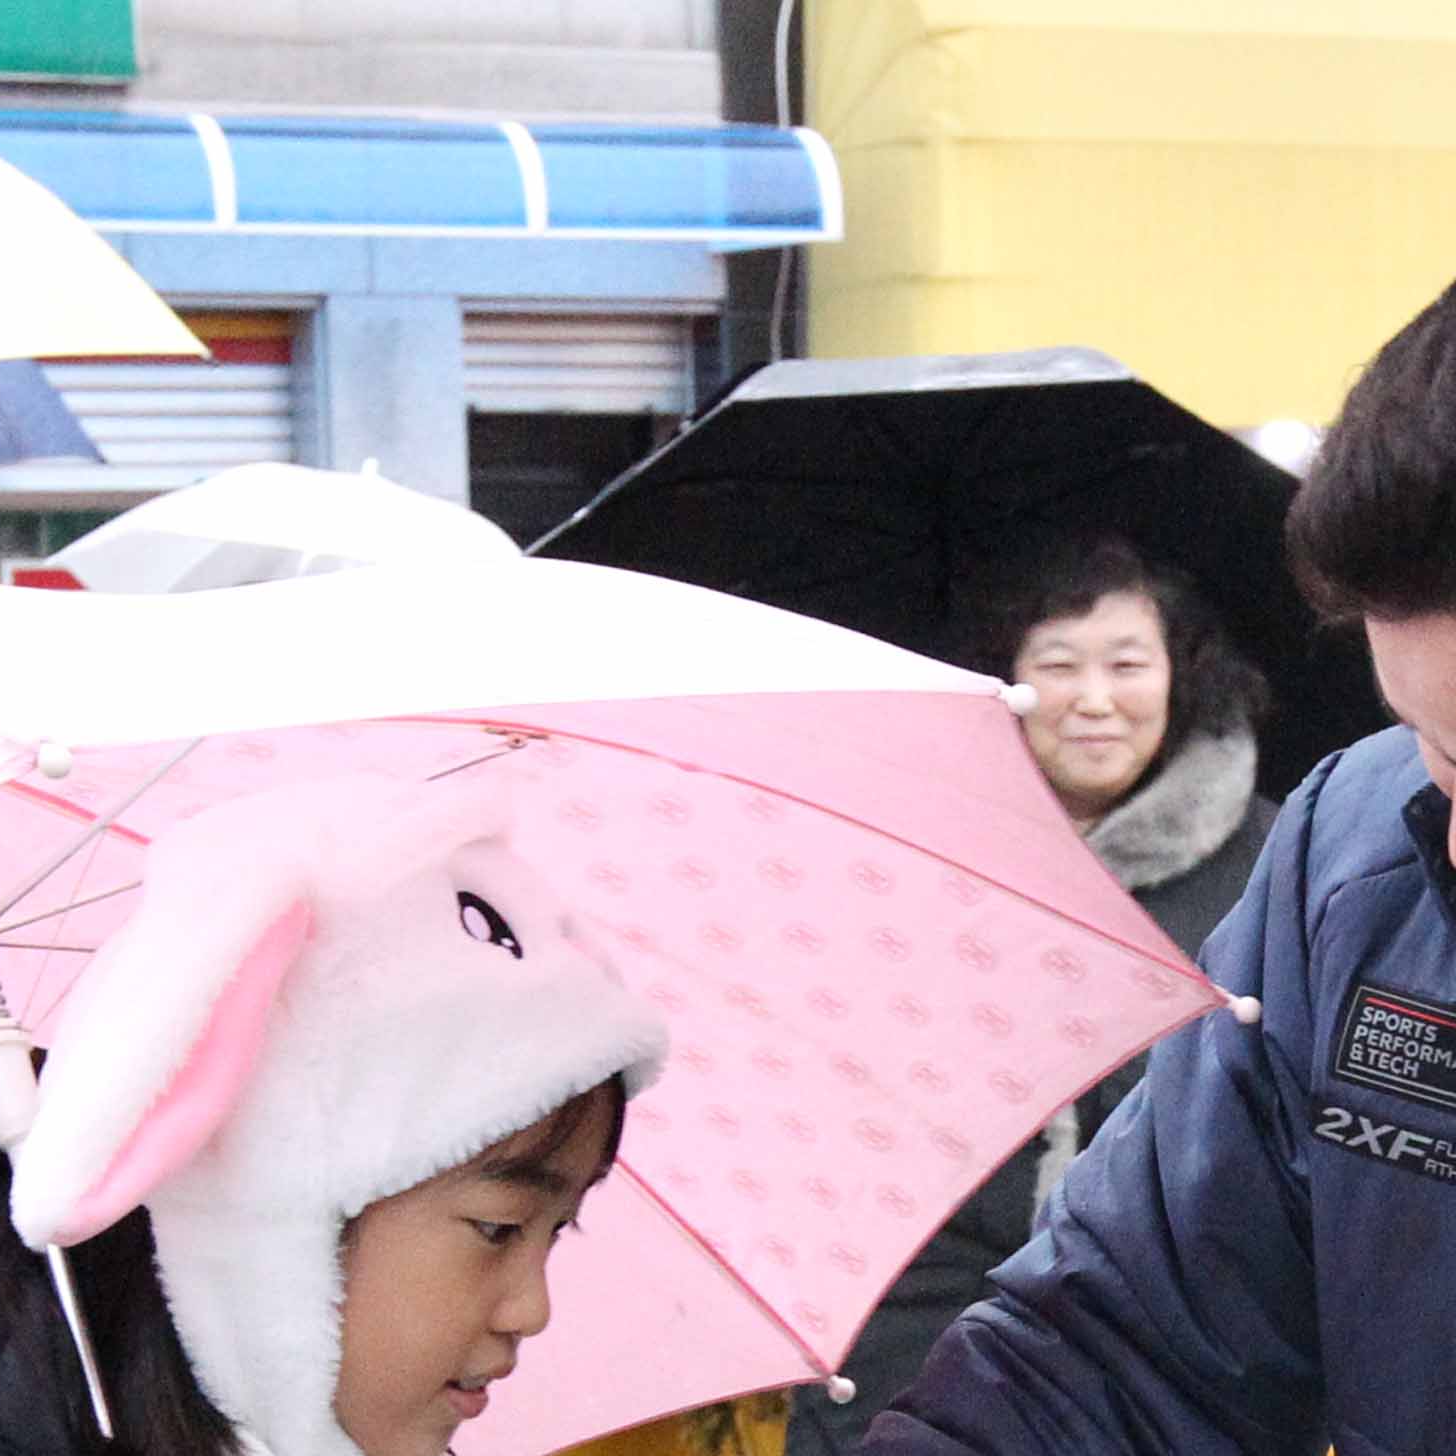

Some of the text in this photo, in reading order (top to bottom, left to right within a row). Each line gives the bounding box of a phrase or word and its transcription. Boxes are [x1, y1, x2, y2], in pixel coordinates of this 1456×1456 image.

[1359, 1006, 1439, 1043] SPORTS
[1348, 1042, 1420, 1079] & TECH
[1314, 1107, 1434, 1161] 2XF
